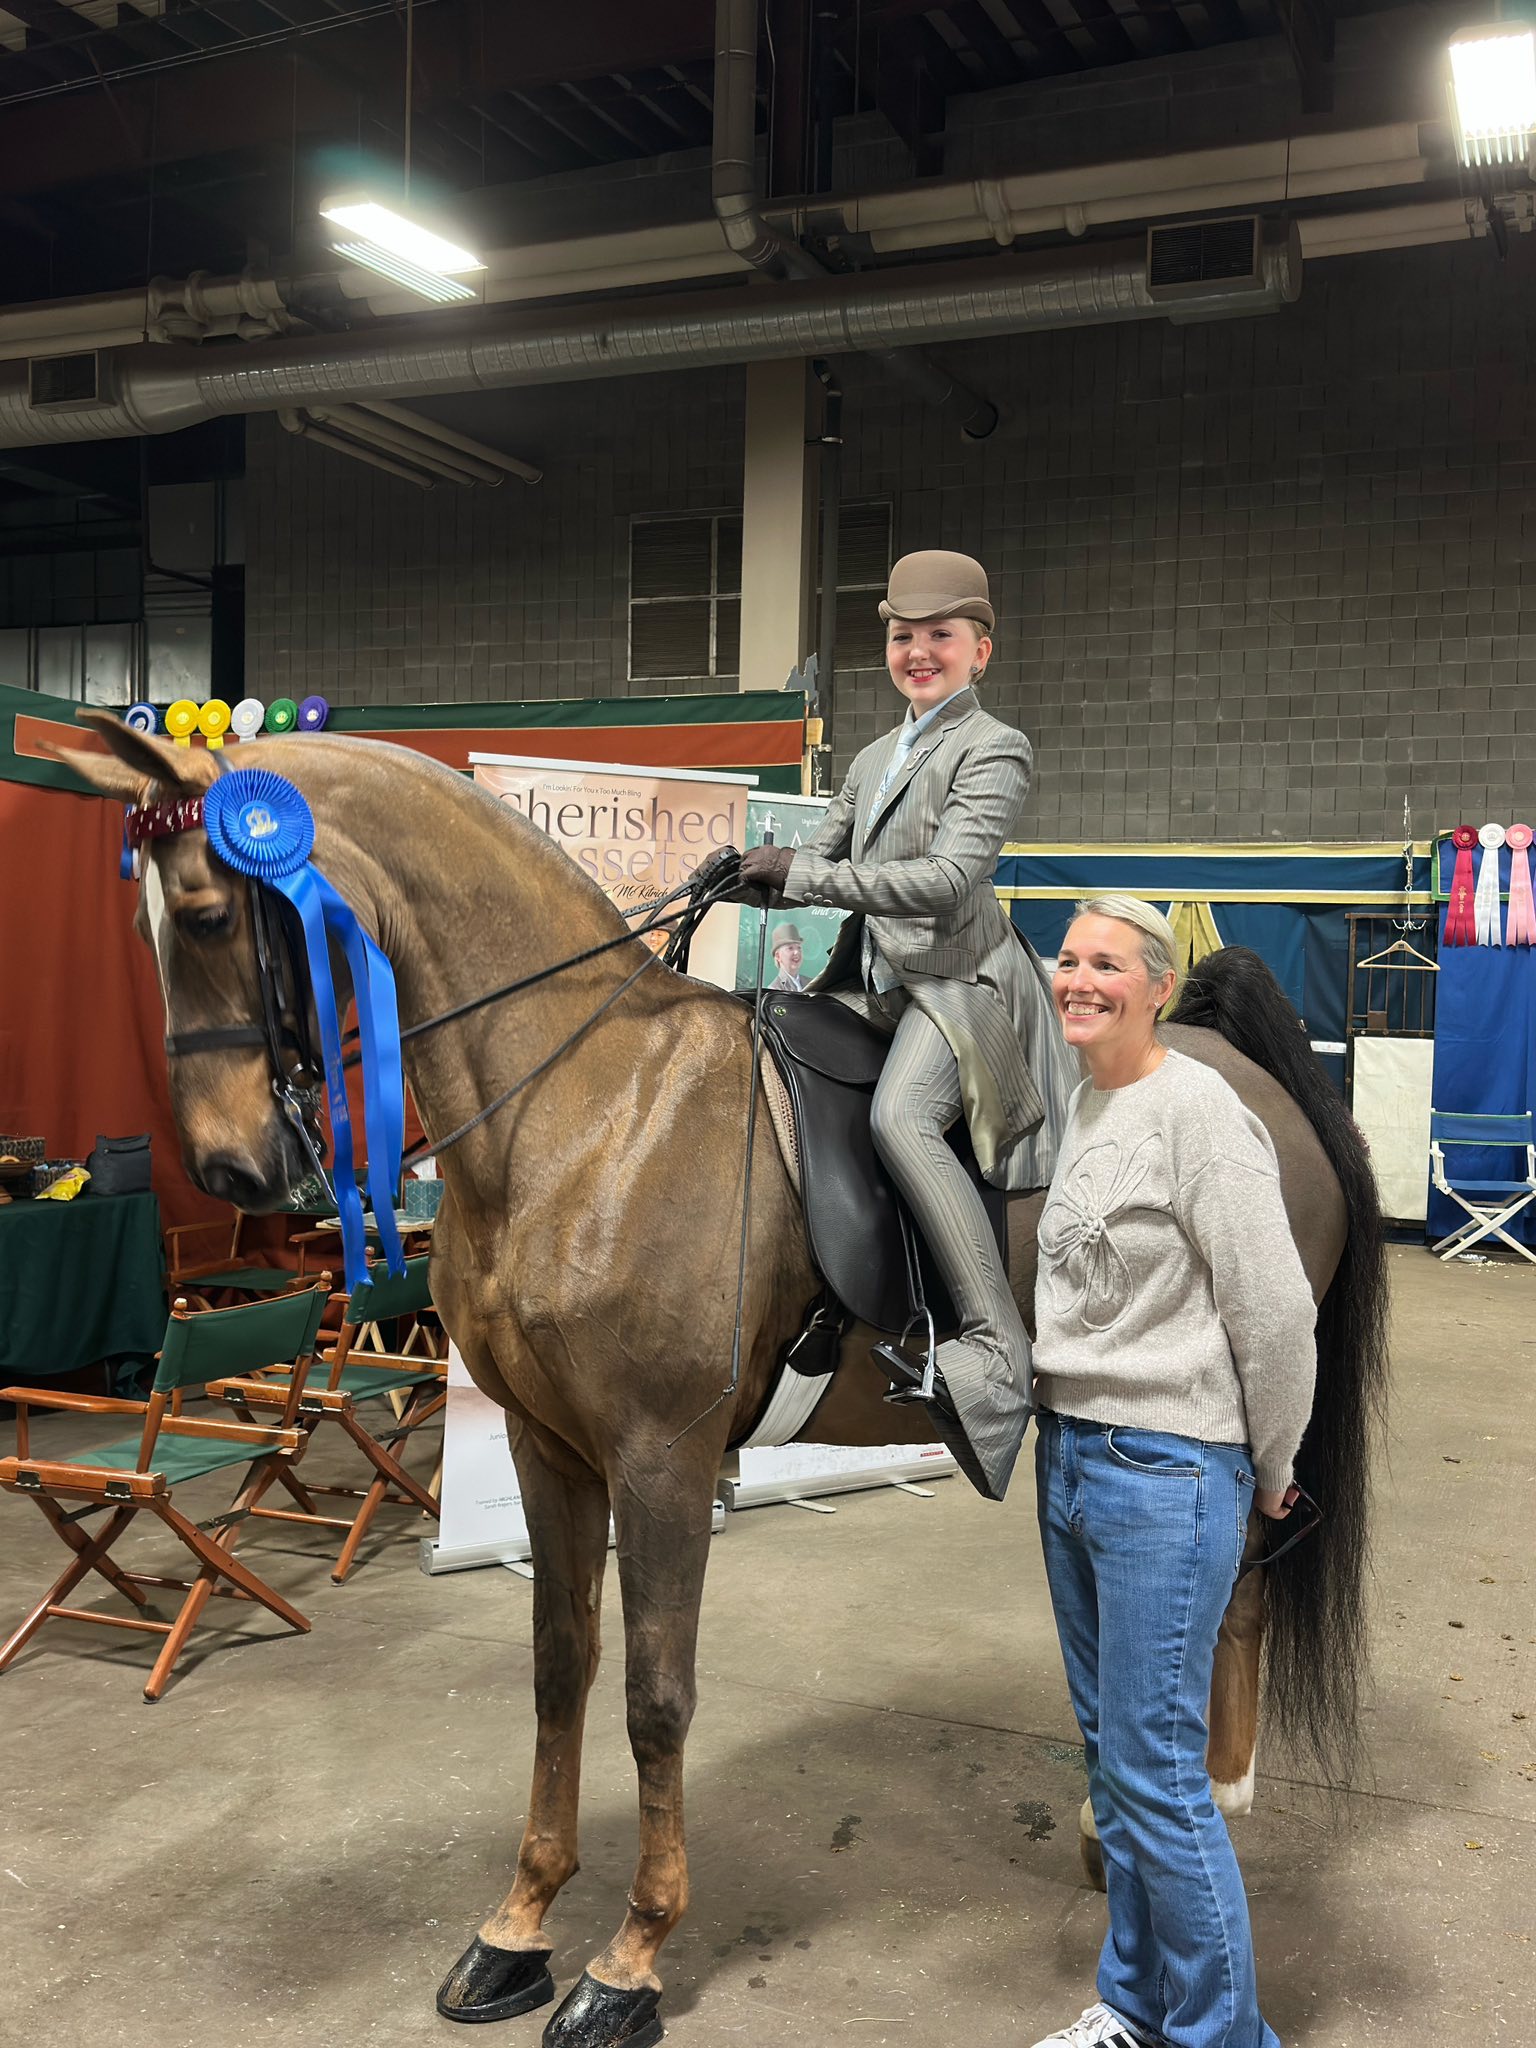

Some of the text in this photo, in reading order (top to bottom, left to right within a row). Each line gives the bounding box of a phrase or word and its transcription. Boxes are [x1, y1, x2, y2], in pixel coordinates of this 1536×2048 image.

[573, 785, 583, 793] For
[583, 786, 594, 794] You
[599, 787, 610, 795] Too
[611, 788, 627, 796] Much
[627, 790, 642, 798] Bling
[556, 839, 698, 885] ssets
[489, 1433, 508, 1441] Junio
